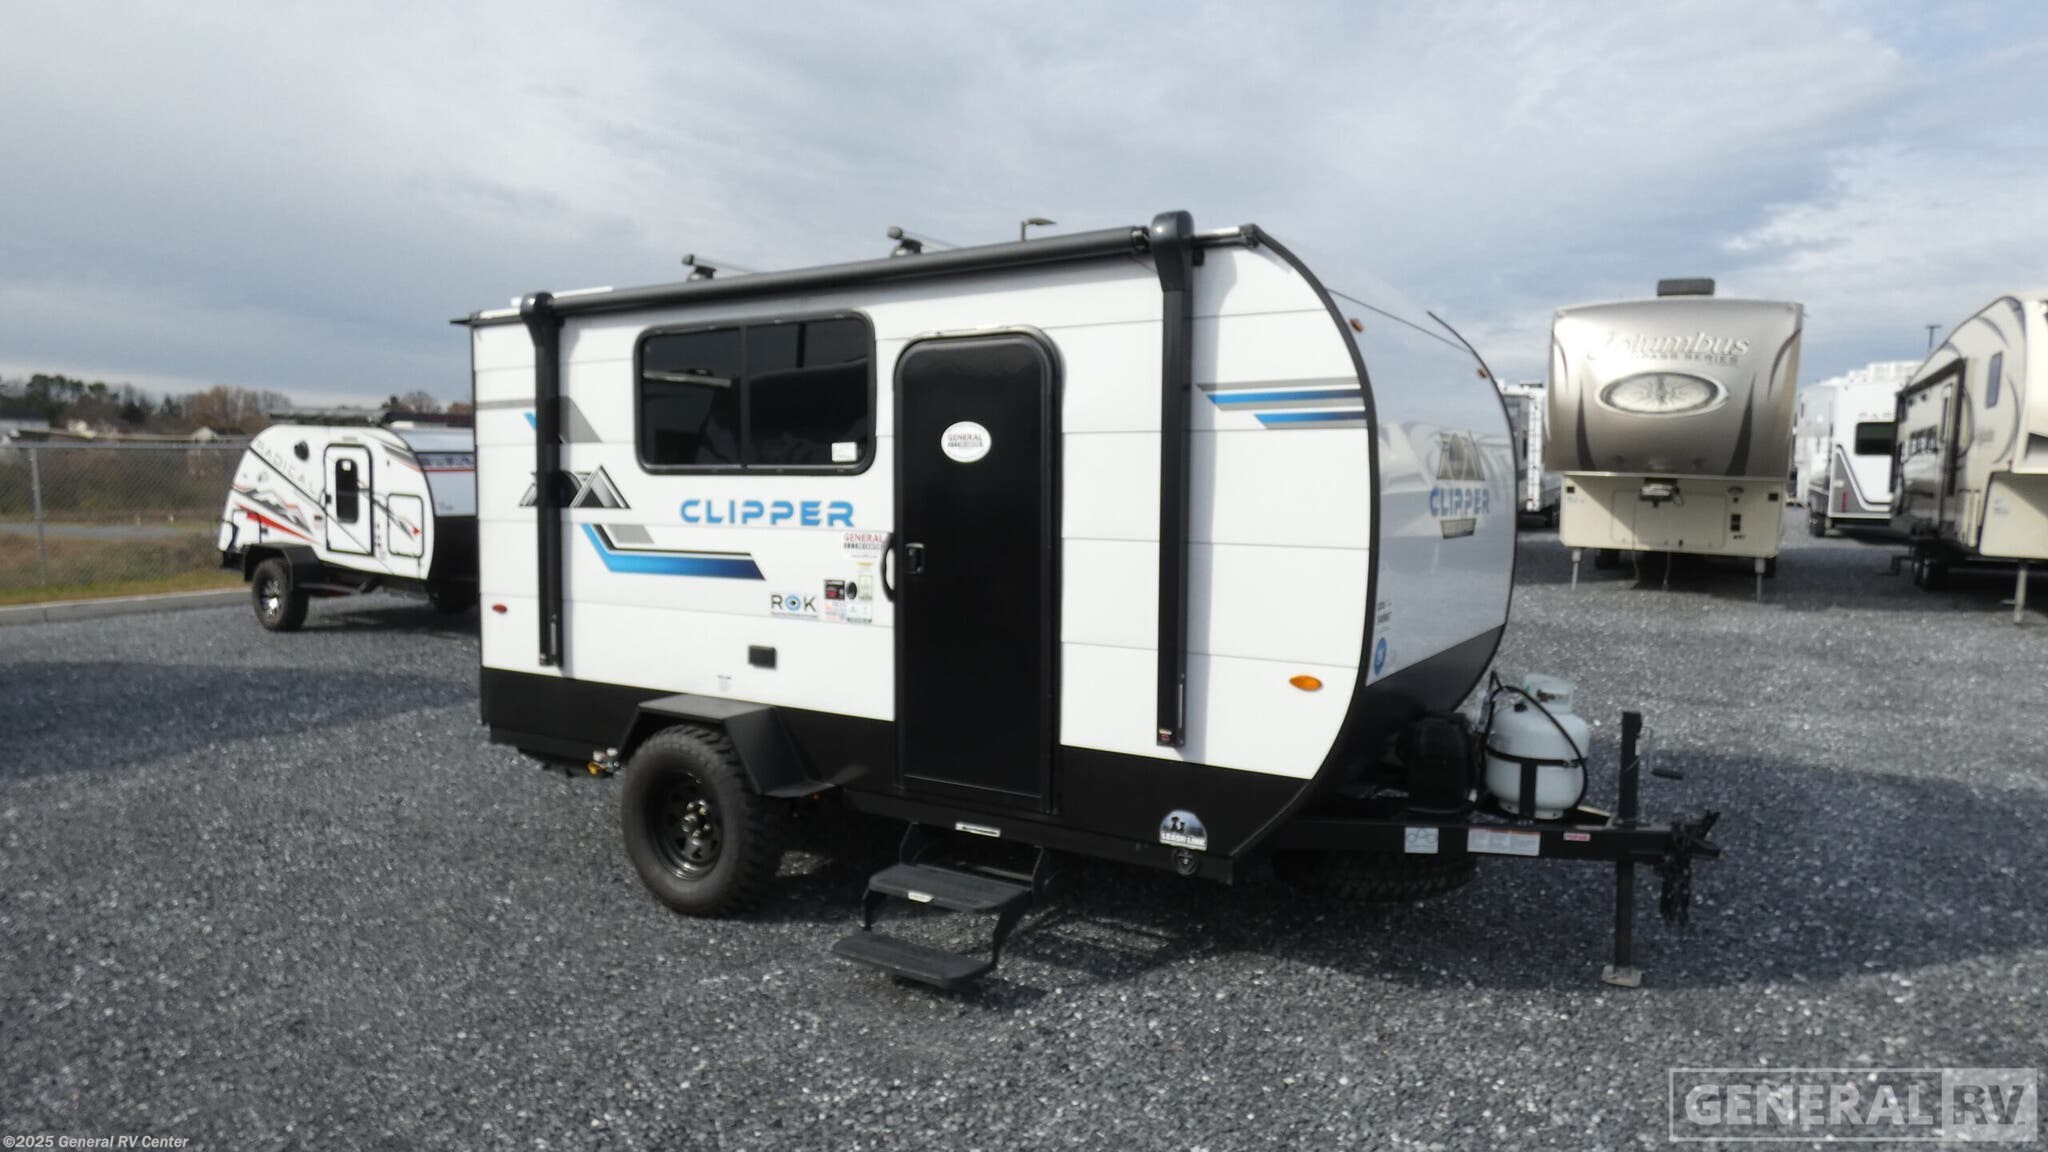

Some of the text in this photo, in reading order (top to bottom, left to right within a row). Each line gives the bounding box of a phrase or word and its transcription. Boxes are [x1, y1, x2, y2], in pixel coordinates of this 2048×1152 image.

[680, 498, 857, 528] CLIPPER
[1430, 486, 1490, 517] CLIPPER
[843, 532, 883, 543] GENERAL
